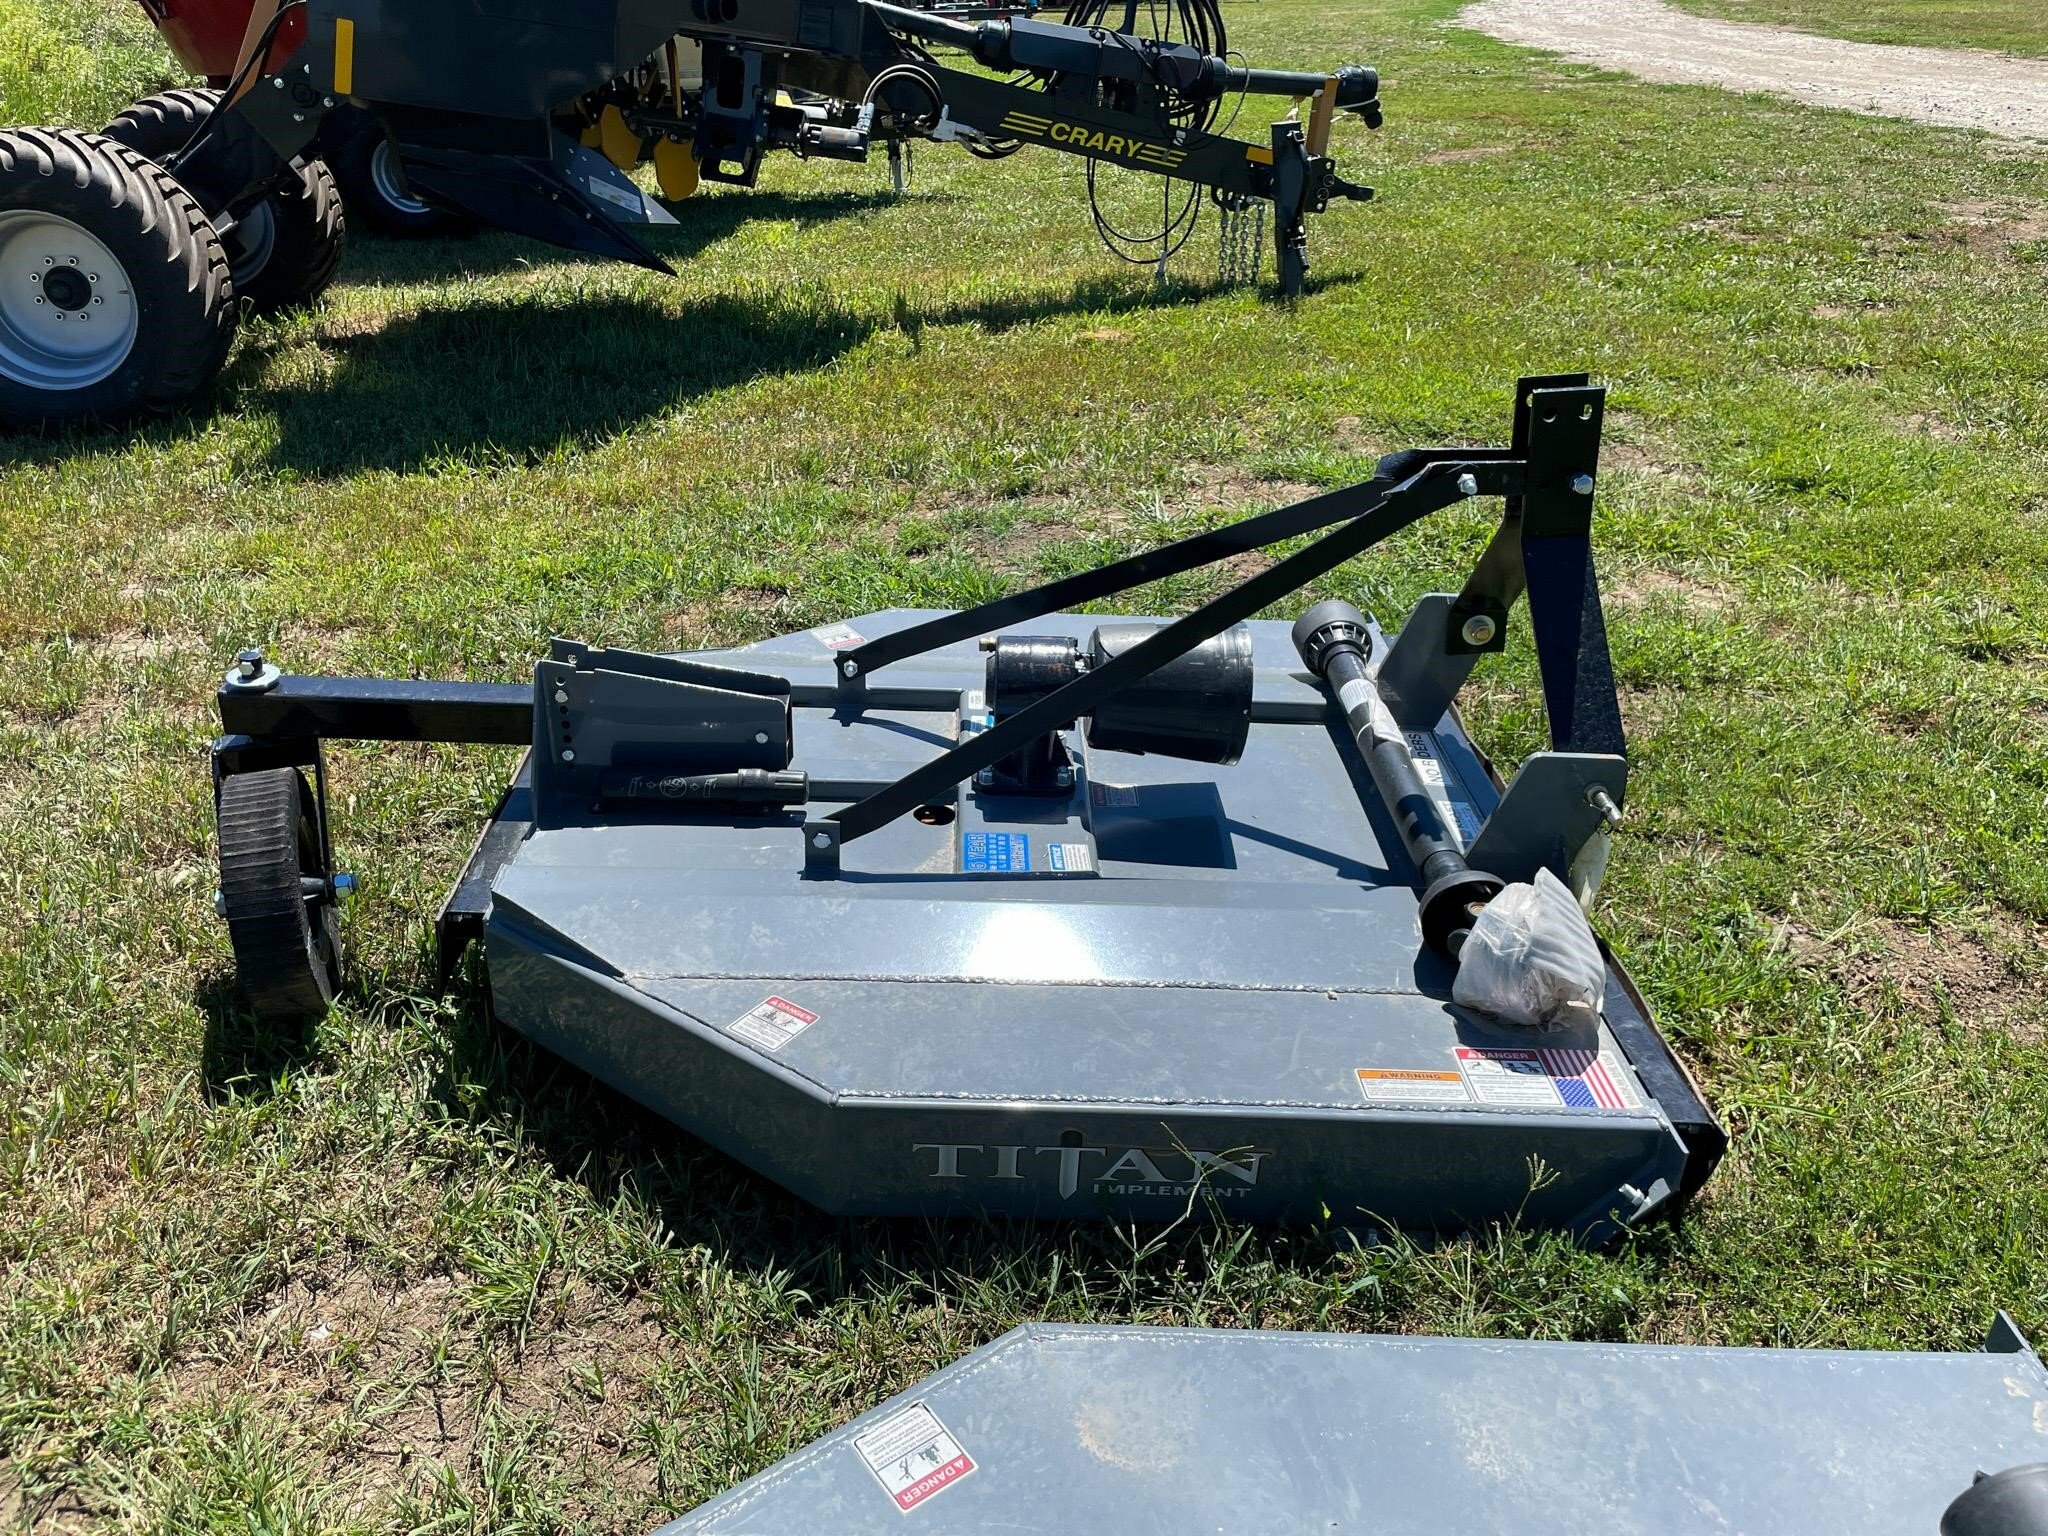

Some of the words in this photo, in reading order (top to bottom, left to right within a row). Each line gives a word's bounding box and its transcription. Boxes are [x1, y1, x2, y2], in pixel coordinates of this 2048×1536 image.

[1050, 123, 1144, 157] CRARY
[1425, 769, 1443, 782] NO
[968, 832, 987, 860] YEAR
[1481, 1051, 1529, 1059] DANGER
[912, 1143, 1272, 1201] TITAN
[1093, 1183, 1252, 1198] IMPLEMENT
[902, 1467, 956, 1503] DANGER
